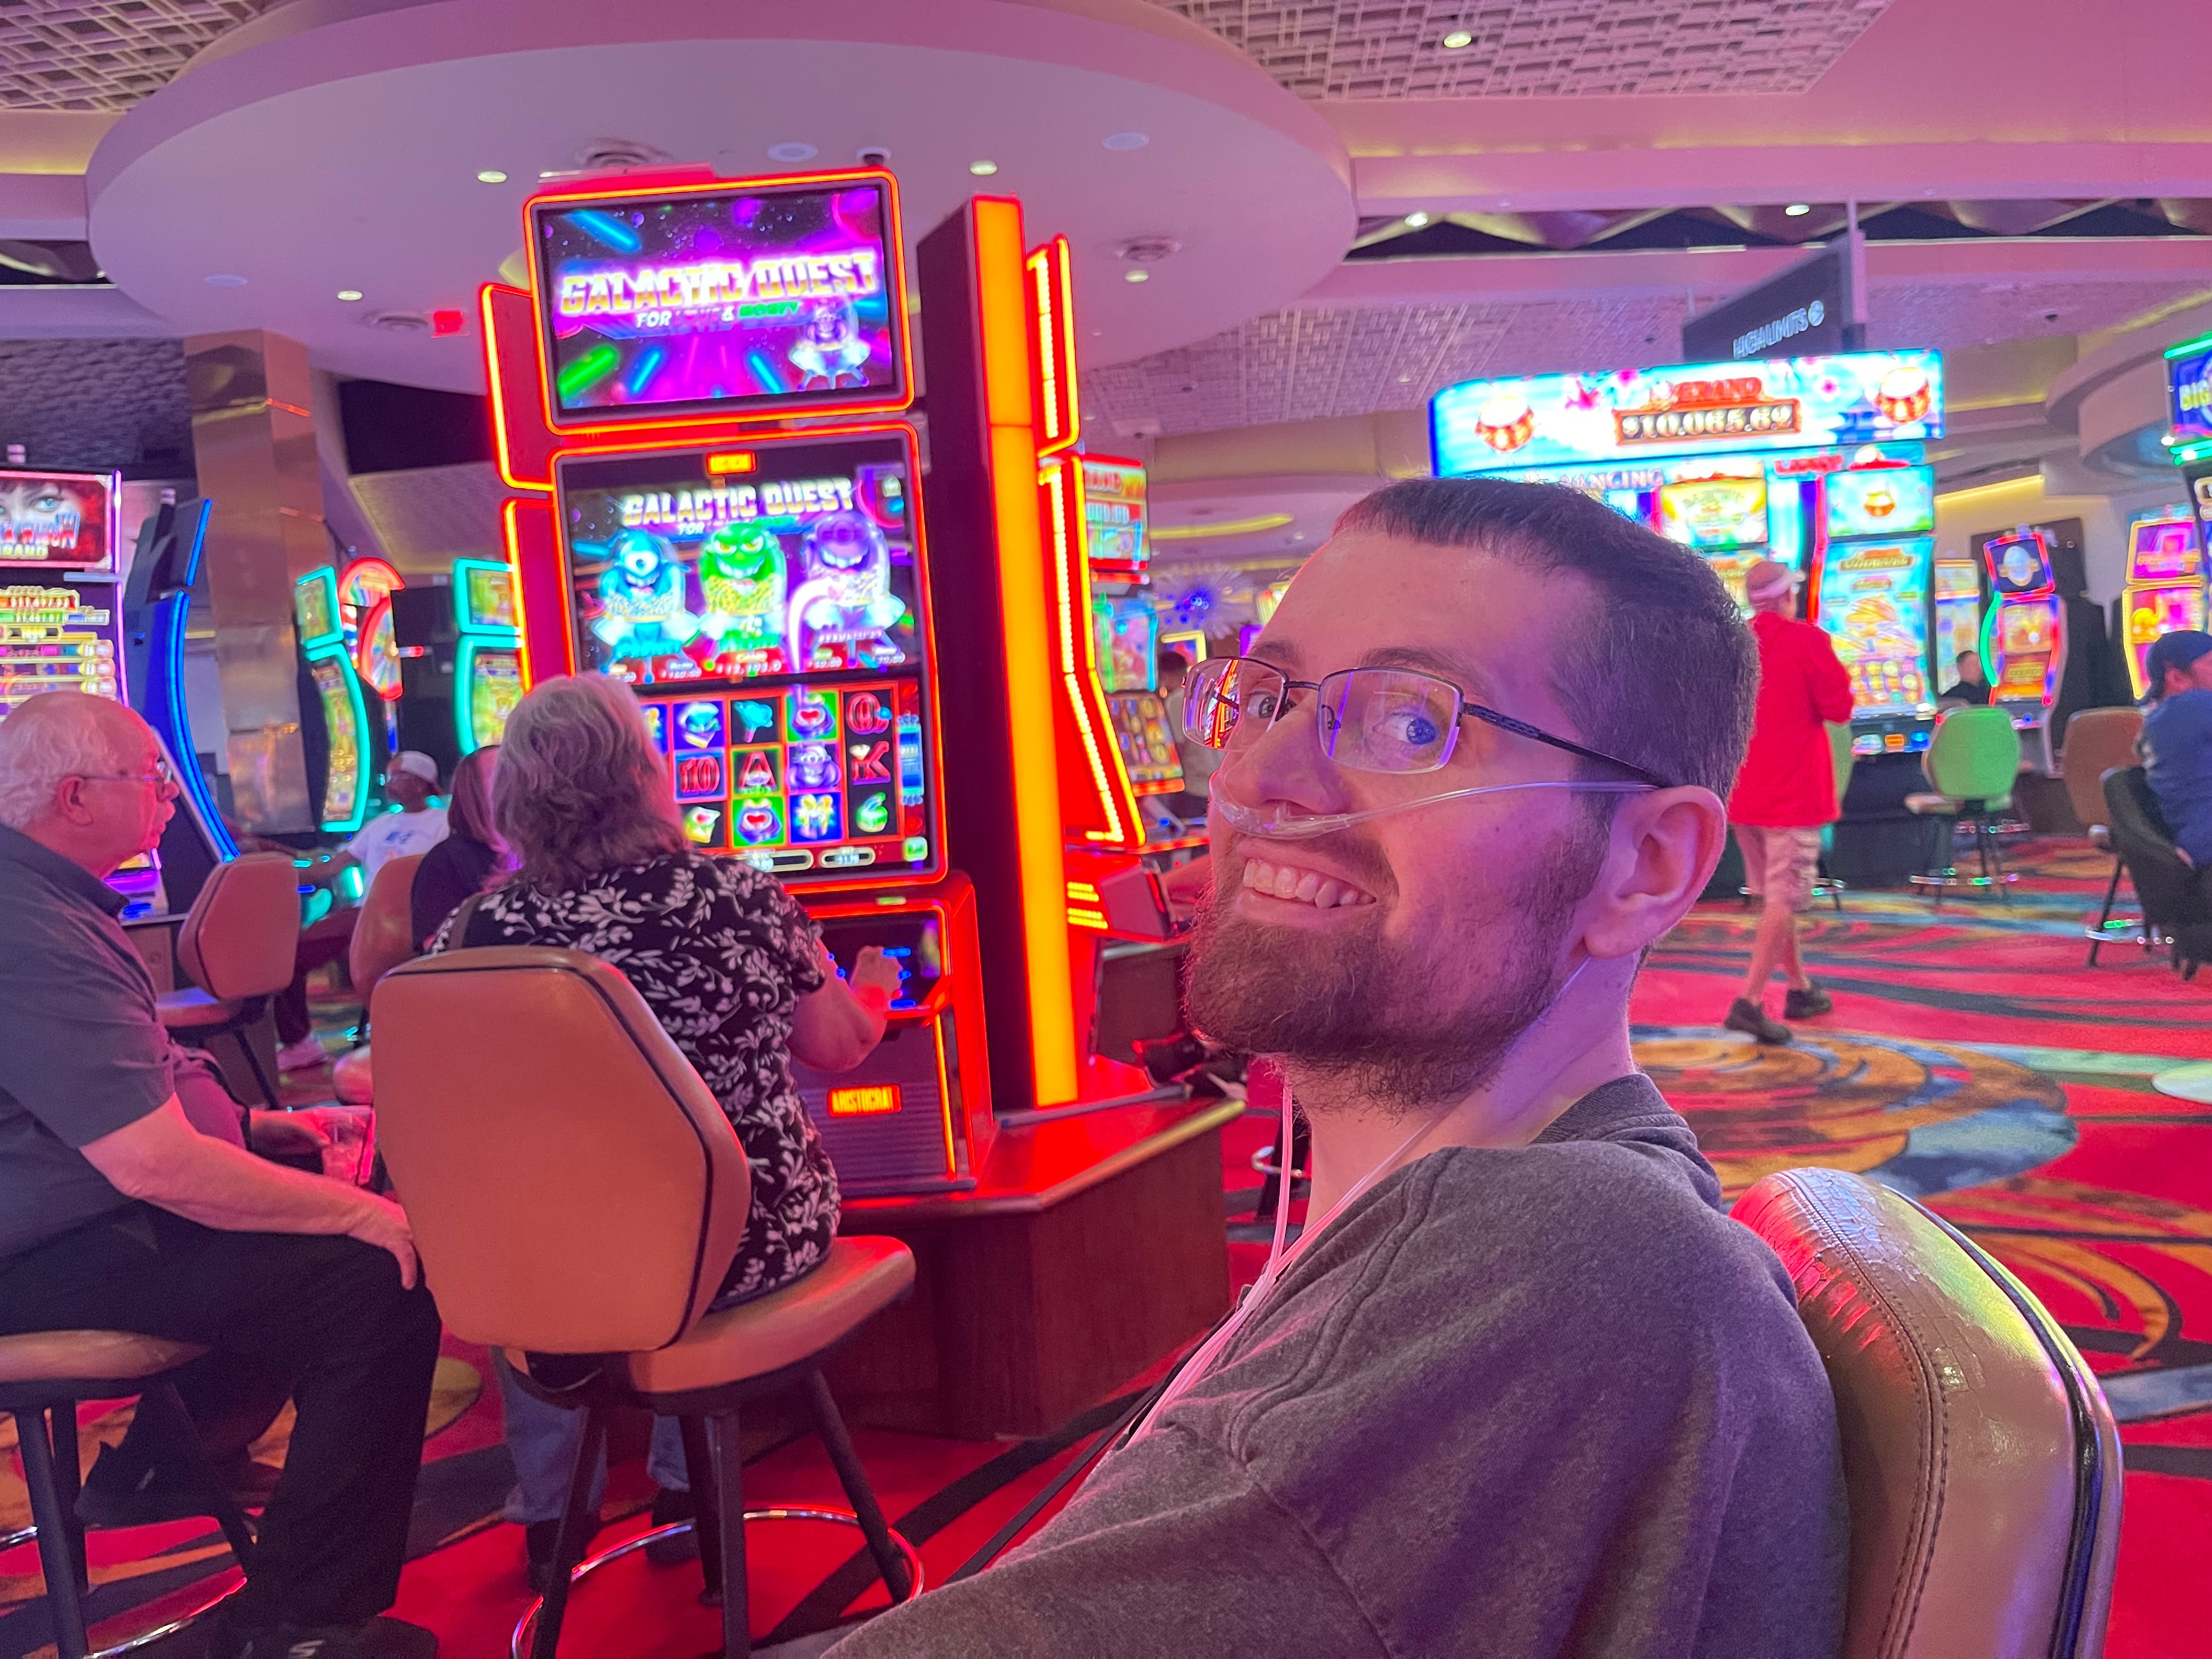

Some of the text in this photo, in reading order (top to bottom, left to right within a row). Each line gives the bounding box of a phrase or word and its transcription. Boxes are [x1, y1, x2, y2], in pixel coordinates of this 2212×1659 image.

[560, 252, 877, 314] GALACTIC QUEST
[636, 309, 673, 329] FOR
[623, 477, 854, 527] GALACTIC QUEST
[678, 522, 706, 535] FOR
[679, 755, 720, 796] 10
[740, 751, 776, 791] A
[851, 740, 891, 786] K
